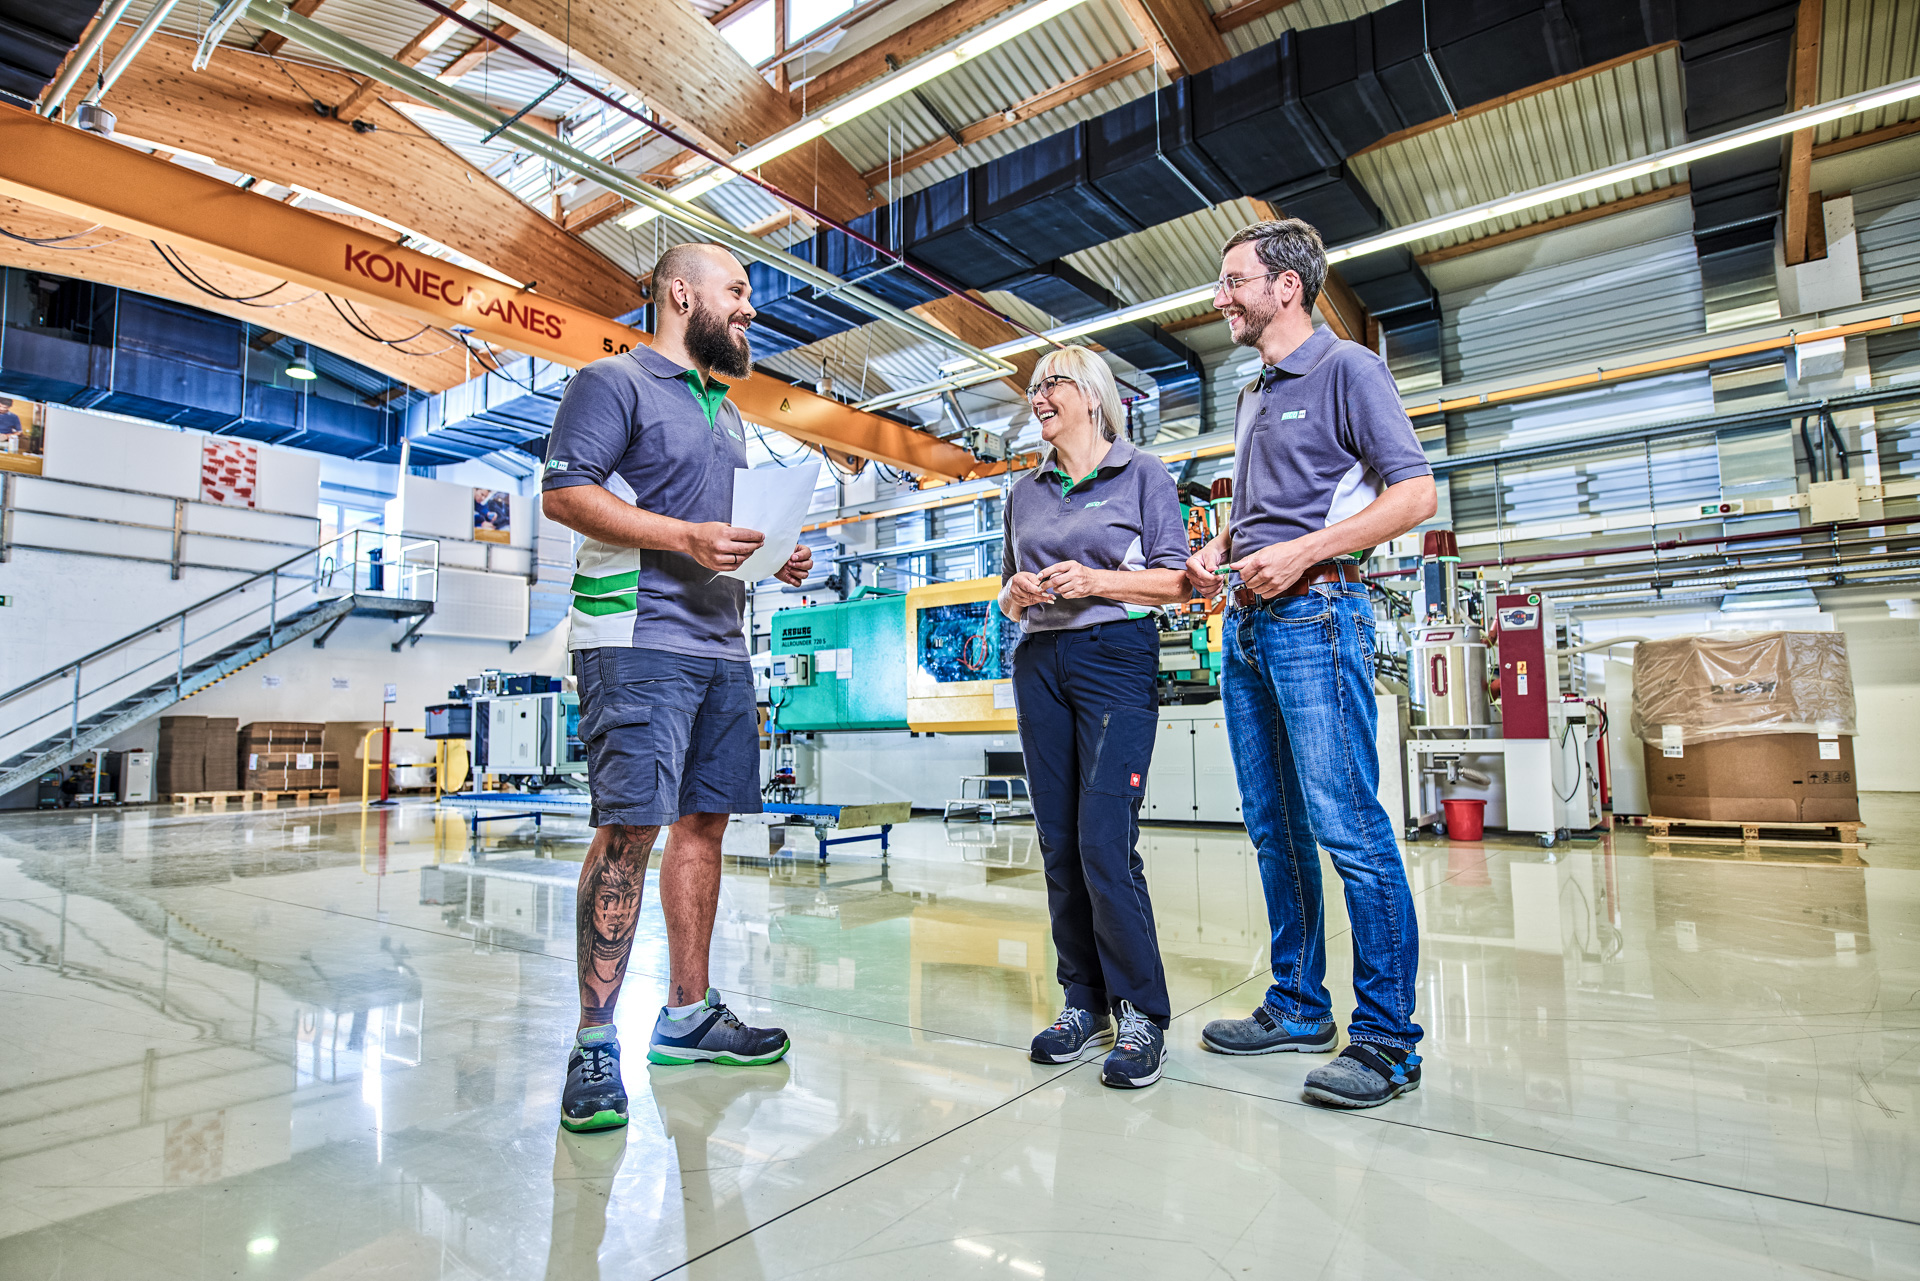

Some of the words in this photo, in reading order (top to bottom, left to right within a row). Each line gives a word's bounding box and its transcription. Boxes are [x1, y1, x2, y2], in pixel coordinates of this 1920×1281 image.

[344, 243, 562, 340] KONECRANES
[782, 627, 811, 636] ARBURG
[583, 1032, 605, 1041] uvex
